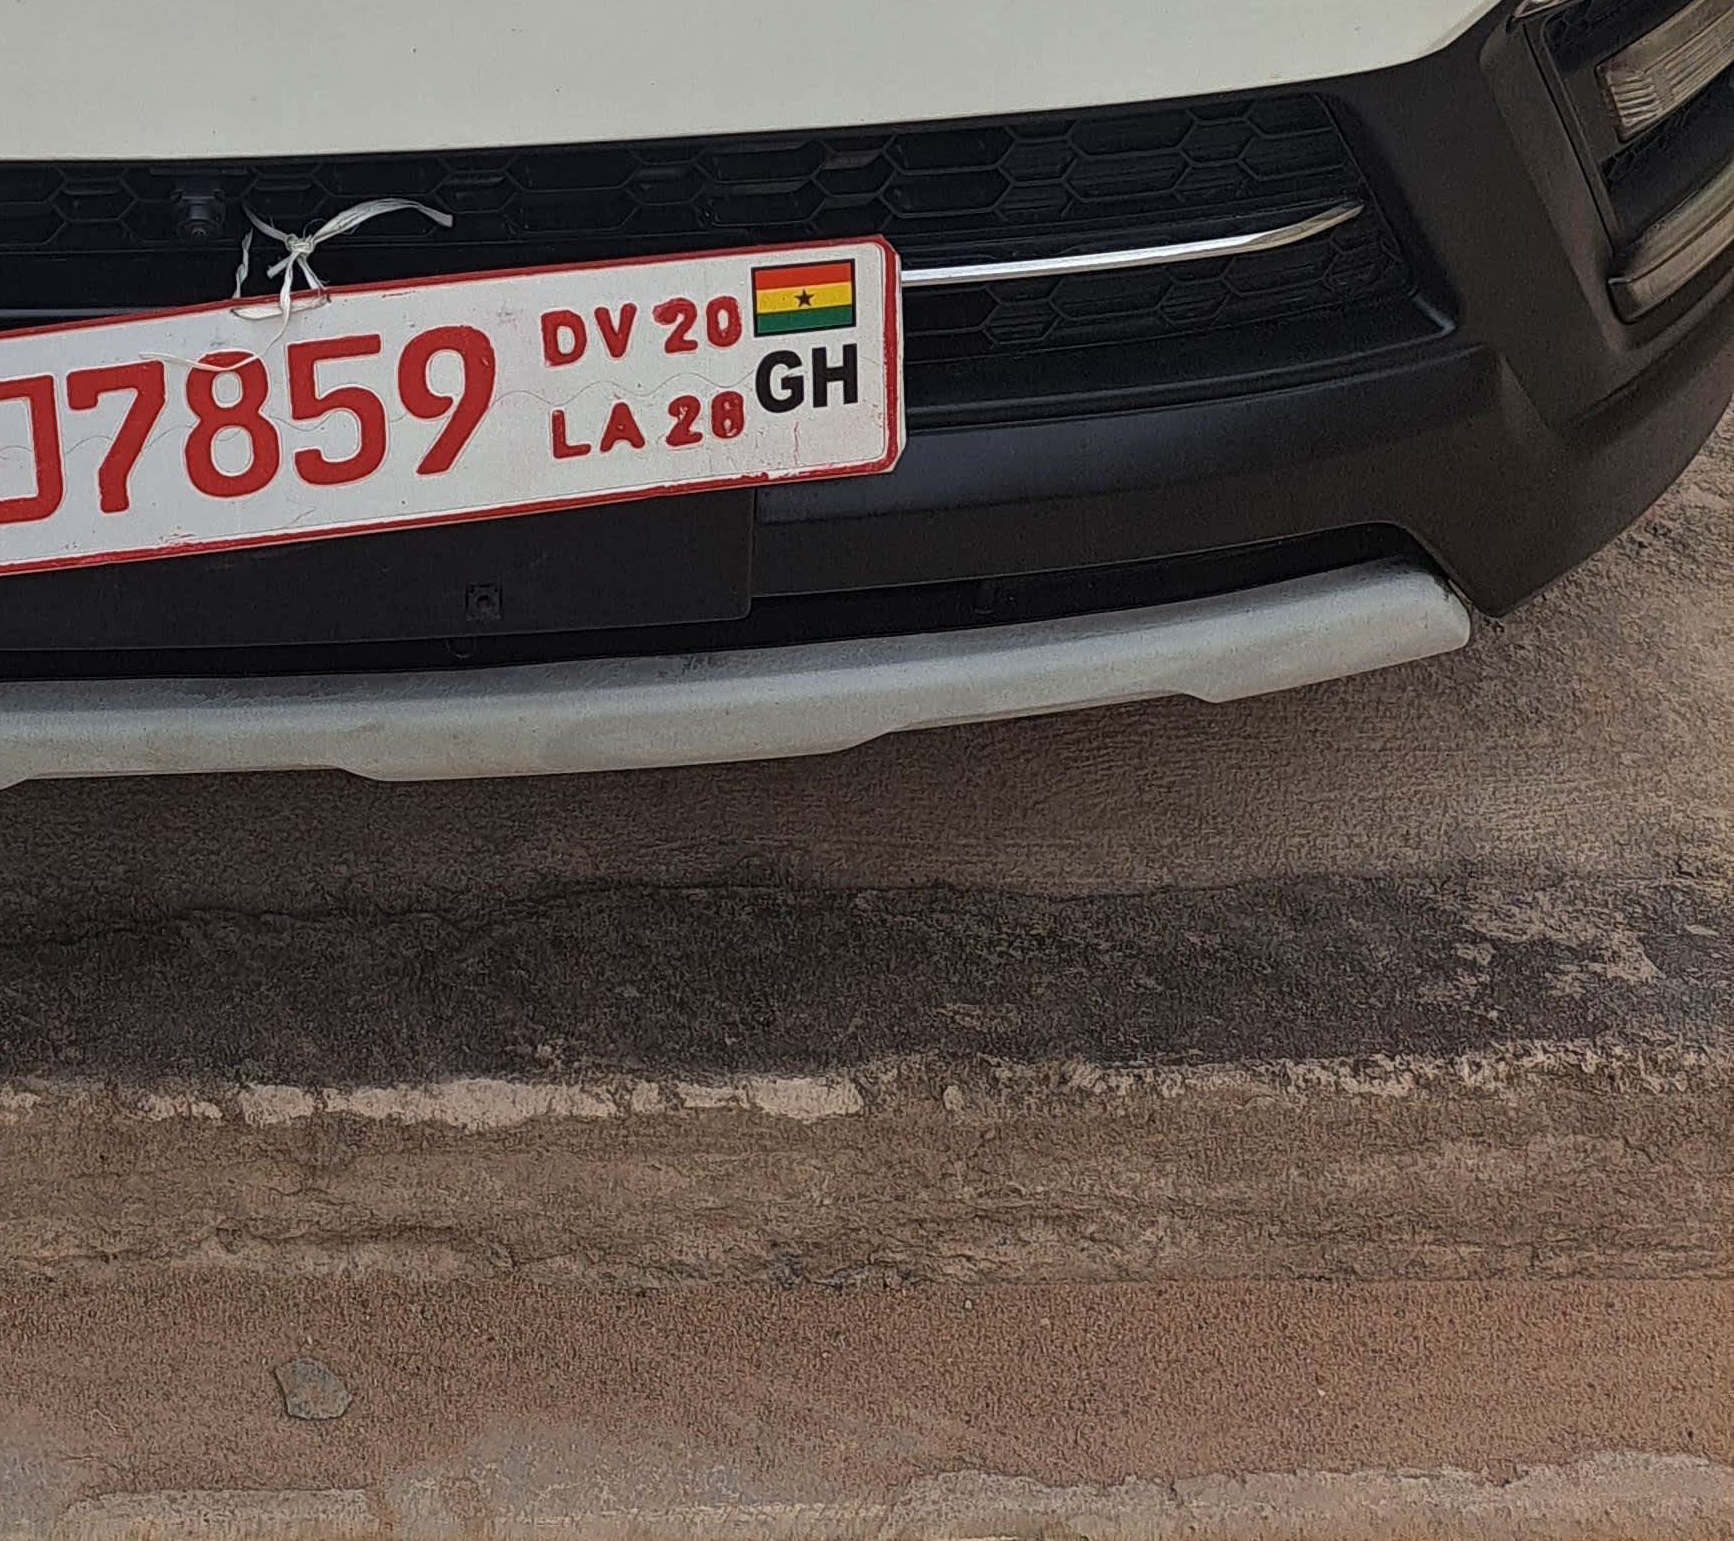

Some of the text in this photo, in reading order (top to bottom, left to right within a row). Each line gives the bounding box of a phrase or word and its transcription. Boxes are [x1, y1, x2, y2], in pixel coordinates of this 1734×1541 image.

[540, 295, 743, 367] DV 20
[754, 343, 859, 414] GH
[550, 401, 646, 460] LA
